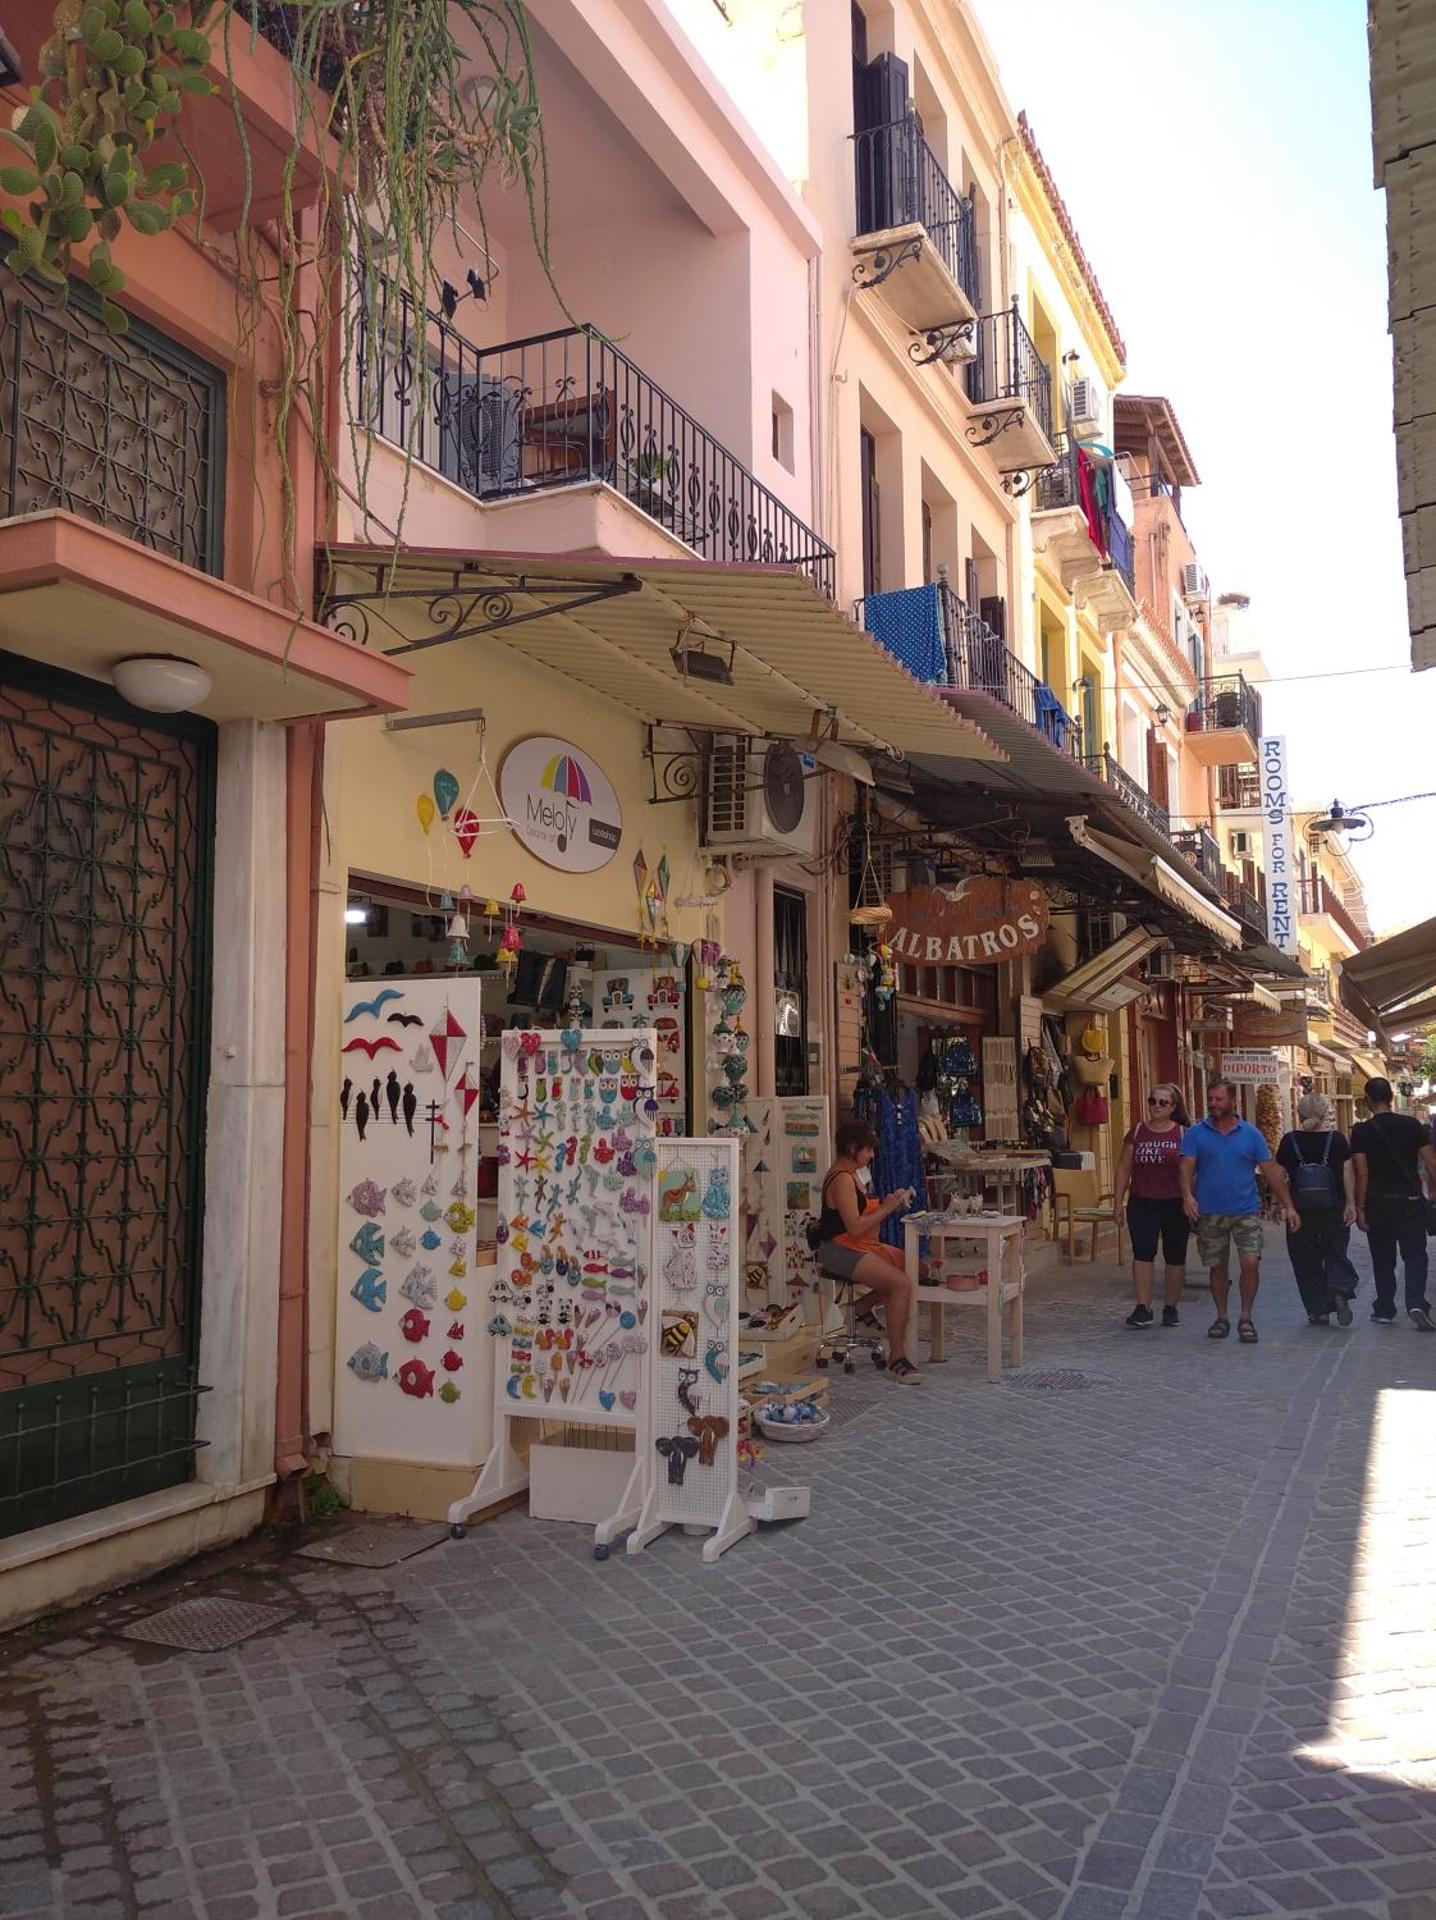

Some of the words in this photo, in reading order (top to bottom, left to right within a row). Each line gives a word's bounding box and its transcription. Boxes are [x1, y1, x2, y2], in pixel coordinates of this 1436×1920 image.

[1264, 741, 1286, 825] ROOMS
[1271, 834, 1285, 873] FOR
[888, 914, 1041, 961] ALBATROS
[1271, 882, 1291, 949] RENT
